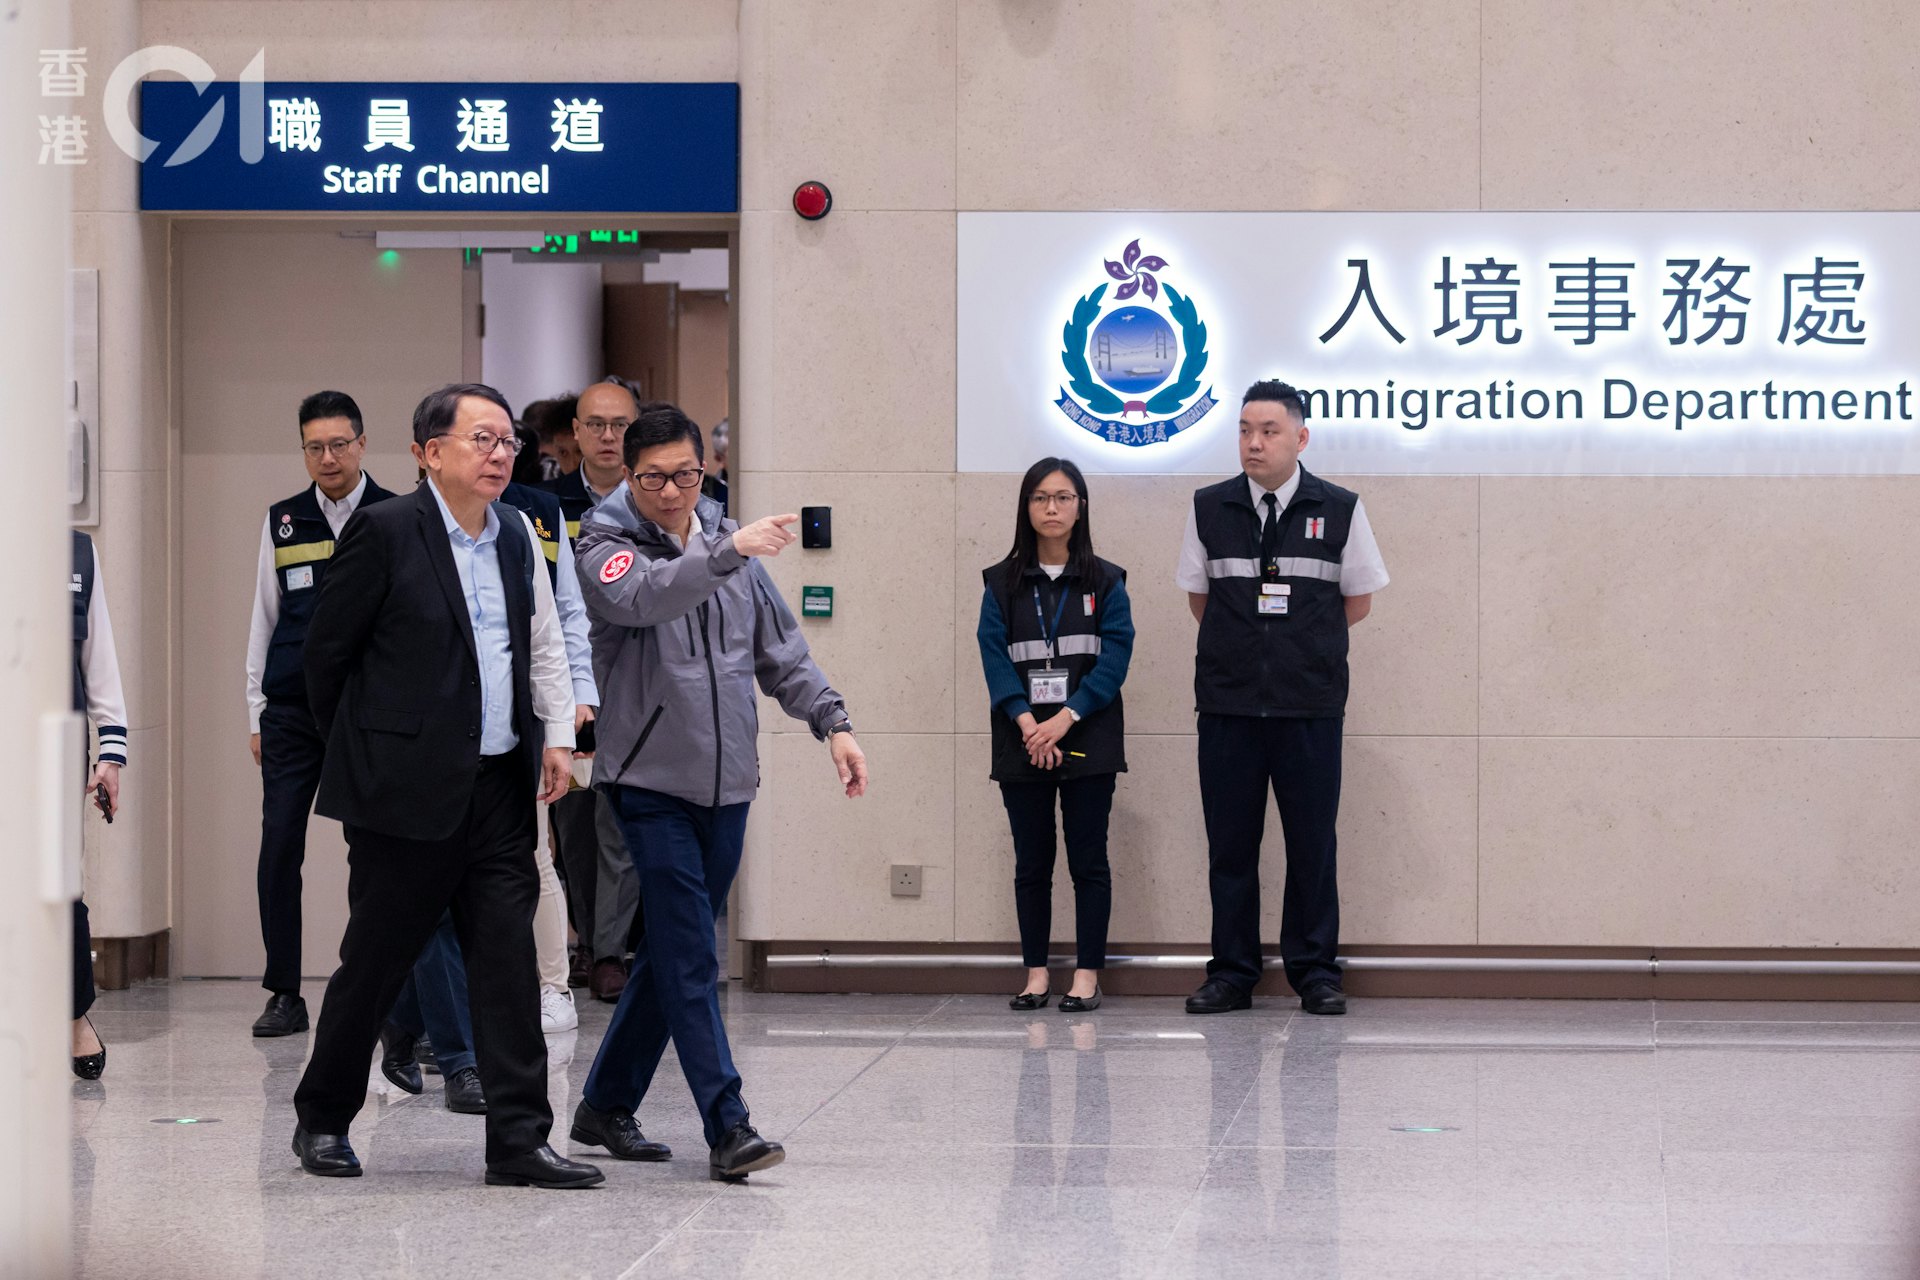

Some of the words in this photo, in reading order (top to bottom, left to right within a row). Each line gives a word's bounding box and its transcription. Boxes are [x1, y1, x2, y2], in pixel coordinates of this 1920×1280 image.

[268, 97, 605, 153] 職員通道
[323, 163, 403, 194] Staff
[417, 163, 550, 194] Channel
[1318, 256, 1867, 346] 入境事務處
[1060, 398, 1082, 421] HONG
[1078, 414, 1102, 433] KONG
[1272, 378, 1584, 431] mmigration
[1603, 379, 1913, 431] Department
[1106, 422, 1168, 444] 香港入境處
